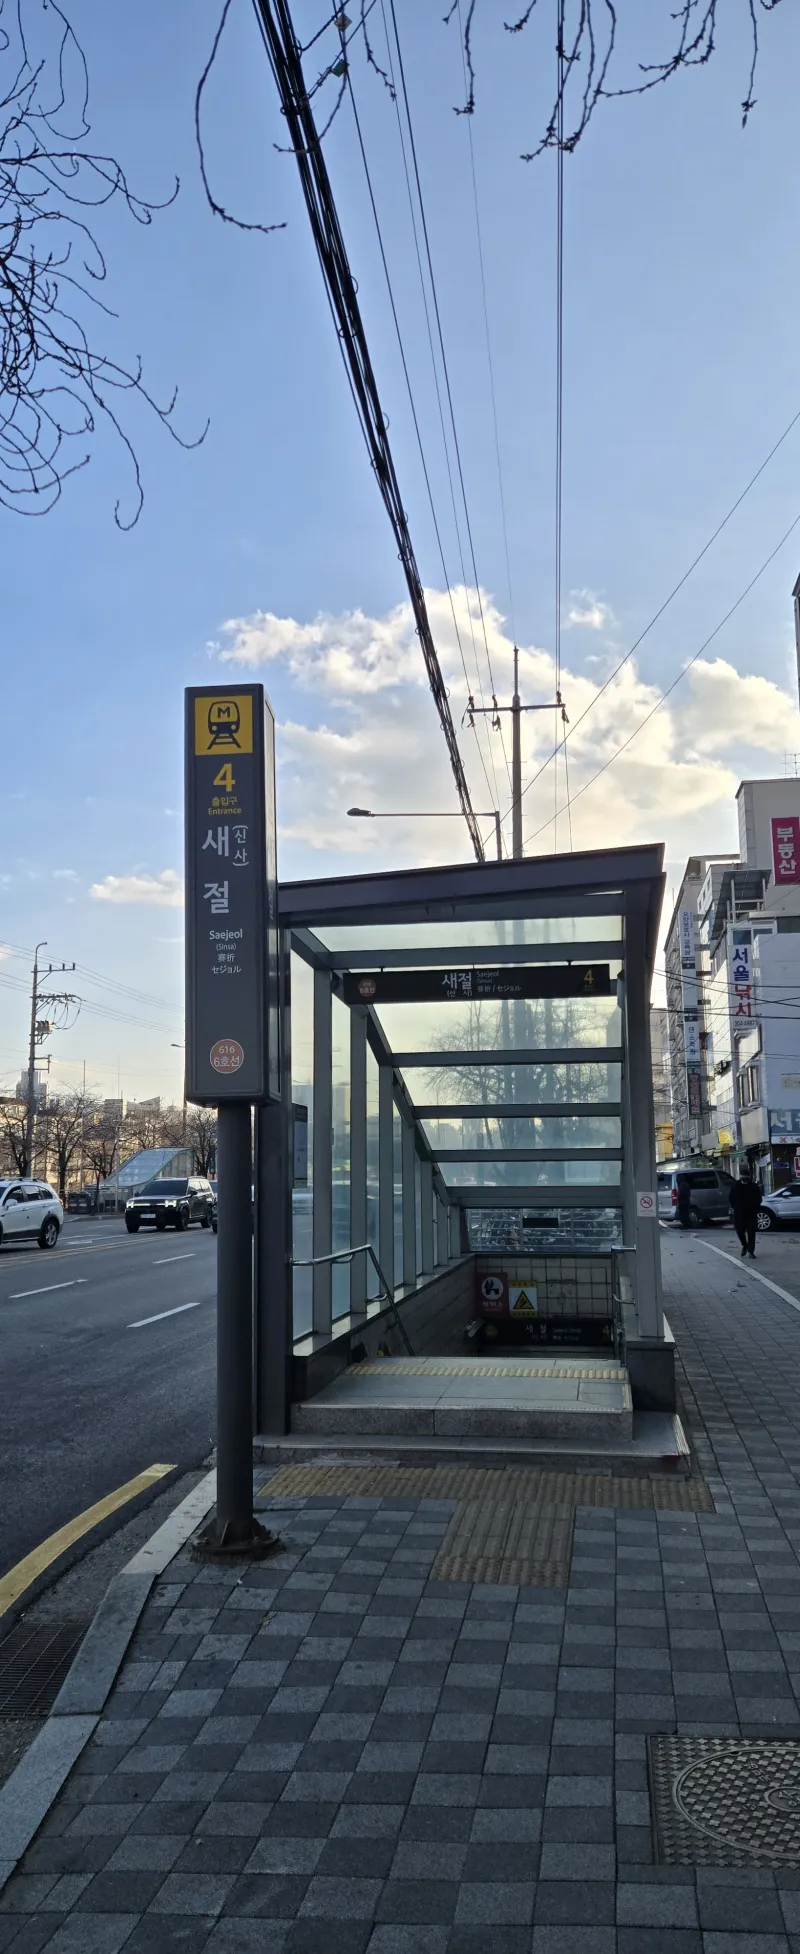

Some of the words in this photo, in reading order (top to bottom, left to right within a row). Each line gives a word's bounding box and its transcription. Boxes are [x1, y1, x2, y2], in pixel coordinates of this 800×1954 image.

[217, 706, 230, 718] M
[213, 763, 235, 792] 4
[212, 796, 237, 807] 출입구
[208, 807, 241, 815] Entrance
[777, 827, 797, 875] 부동산
[209, 929, 243, 941] Saejeol
[216, 943, 236, 951] (Sinsa)
[211, 965, 242, 974] セジョル
[476, 969, 500, 979] Saejeol
[441, 972, 472, 990] 새절
[583, 968, 595, 985] 4
[218, 1045, 236, 1054] 616
[213, 1055, 241, 1067] 6호선
